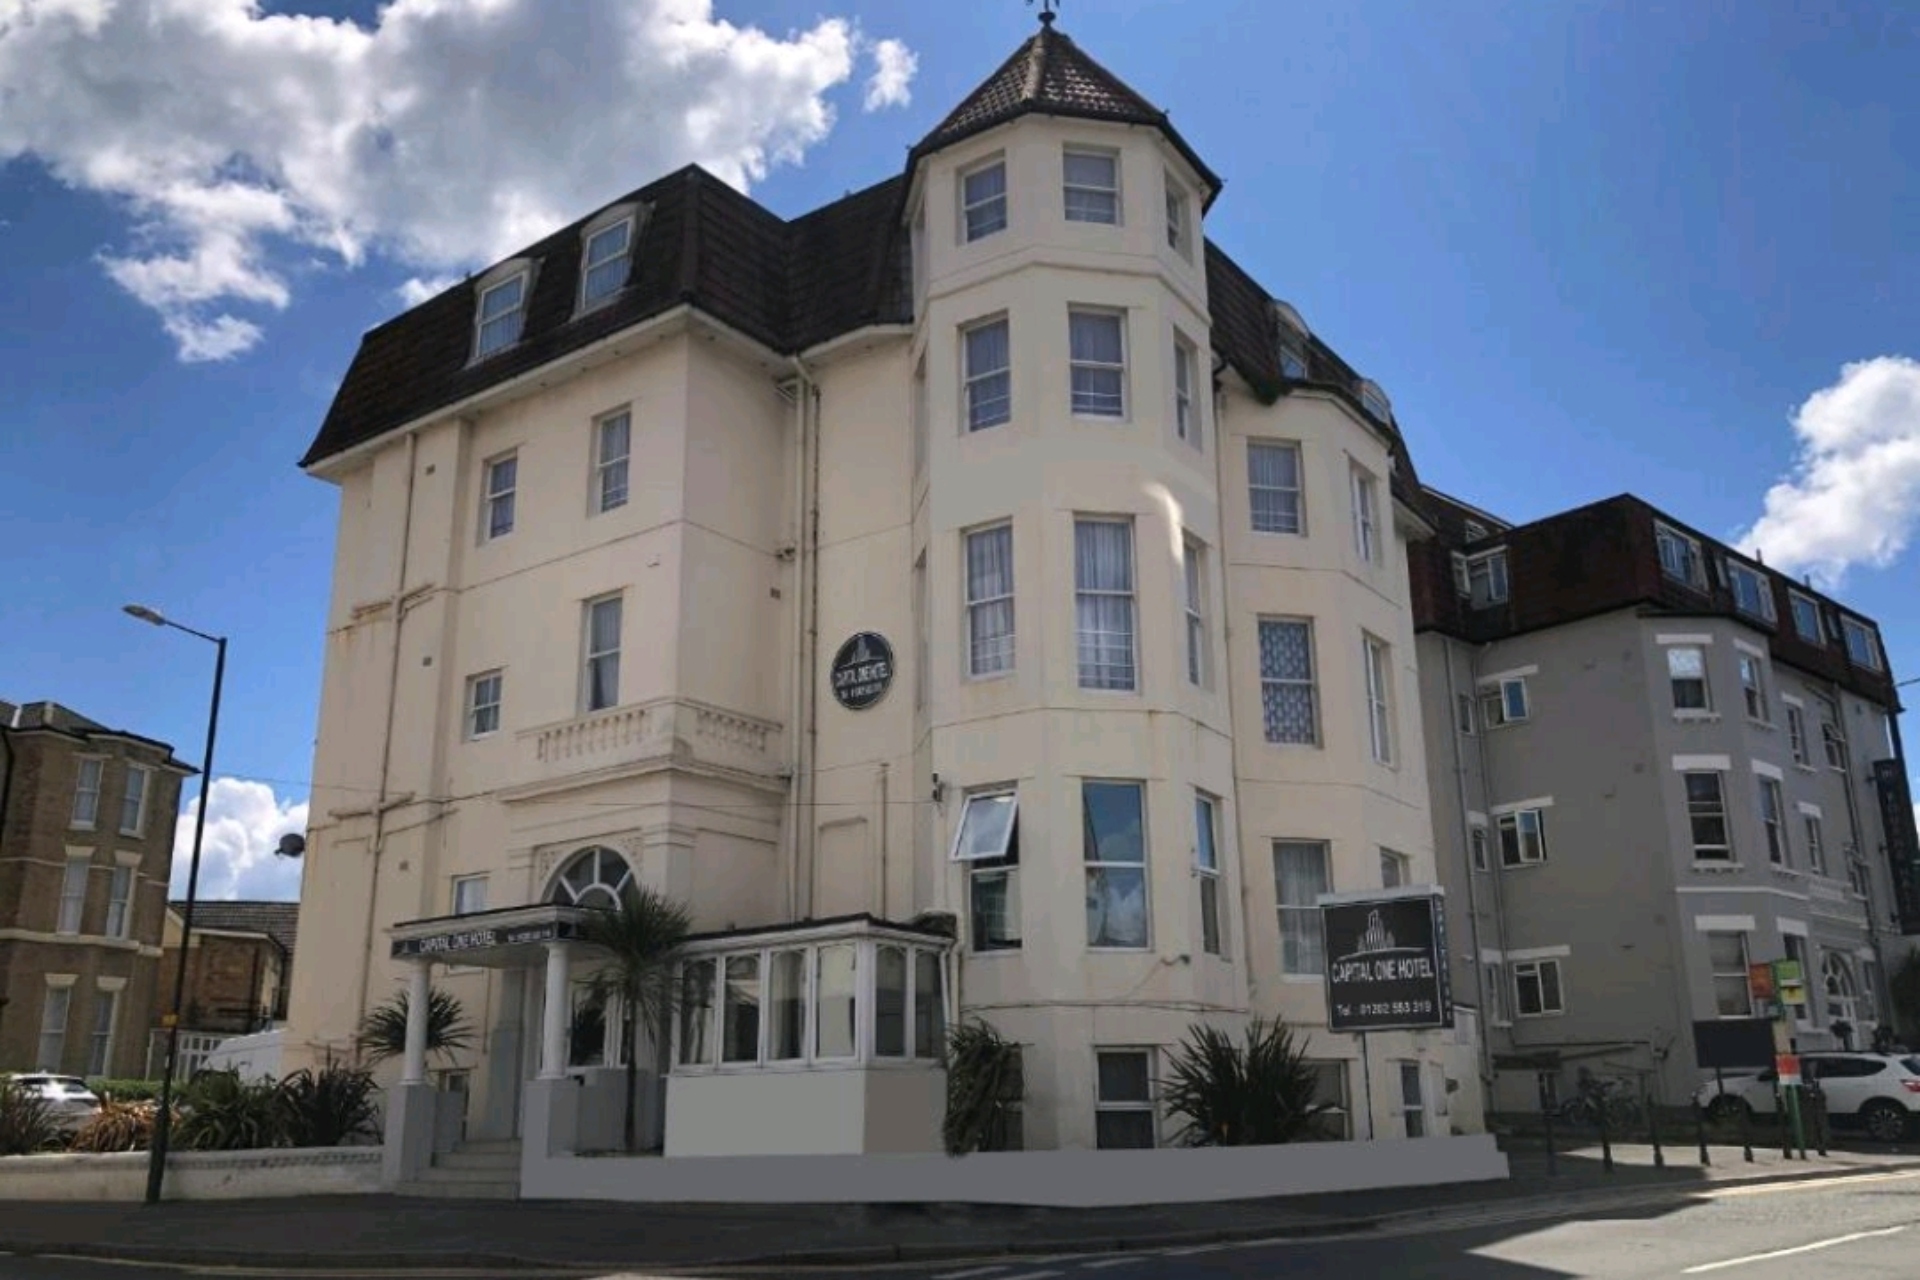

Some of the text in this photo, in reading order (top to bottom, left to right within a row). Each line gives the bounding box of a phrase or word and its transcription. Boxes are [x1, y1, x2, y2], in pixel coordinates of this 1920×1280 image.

[1332, 956, 1434, 984] CAPITAL ONE HOTEL
